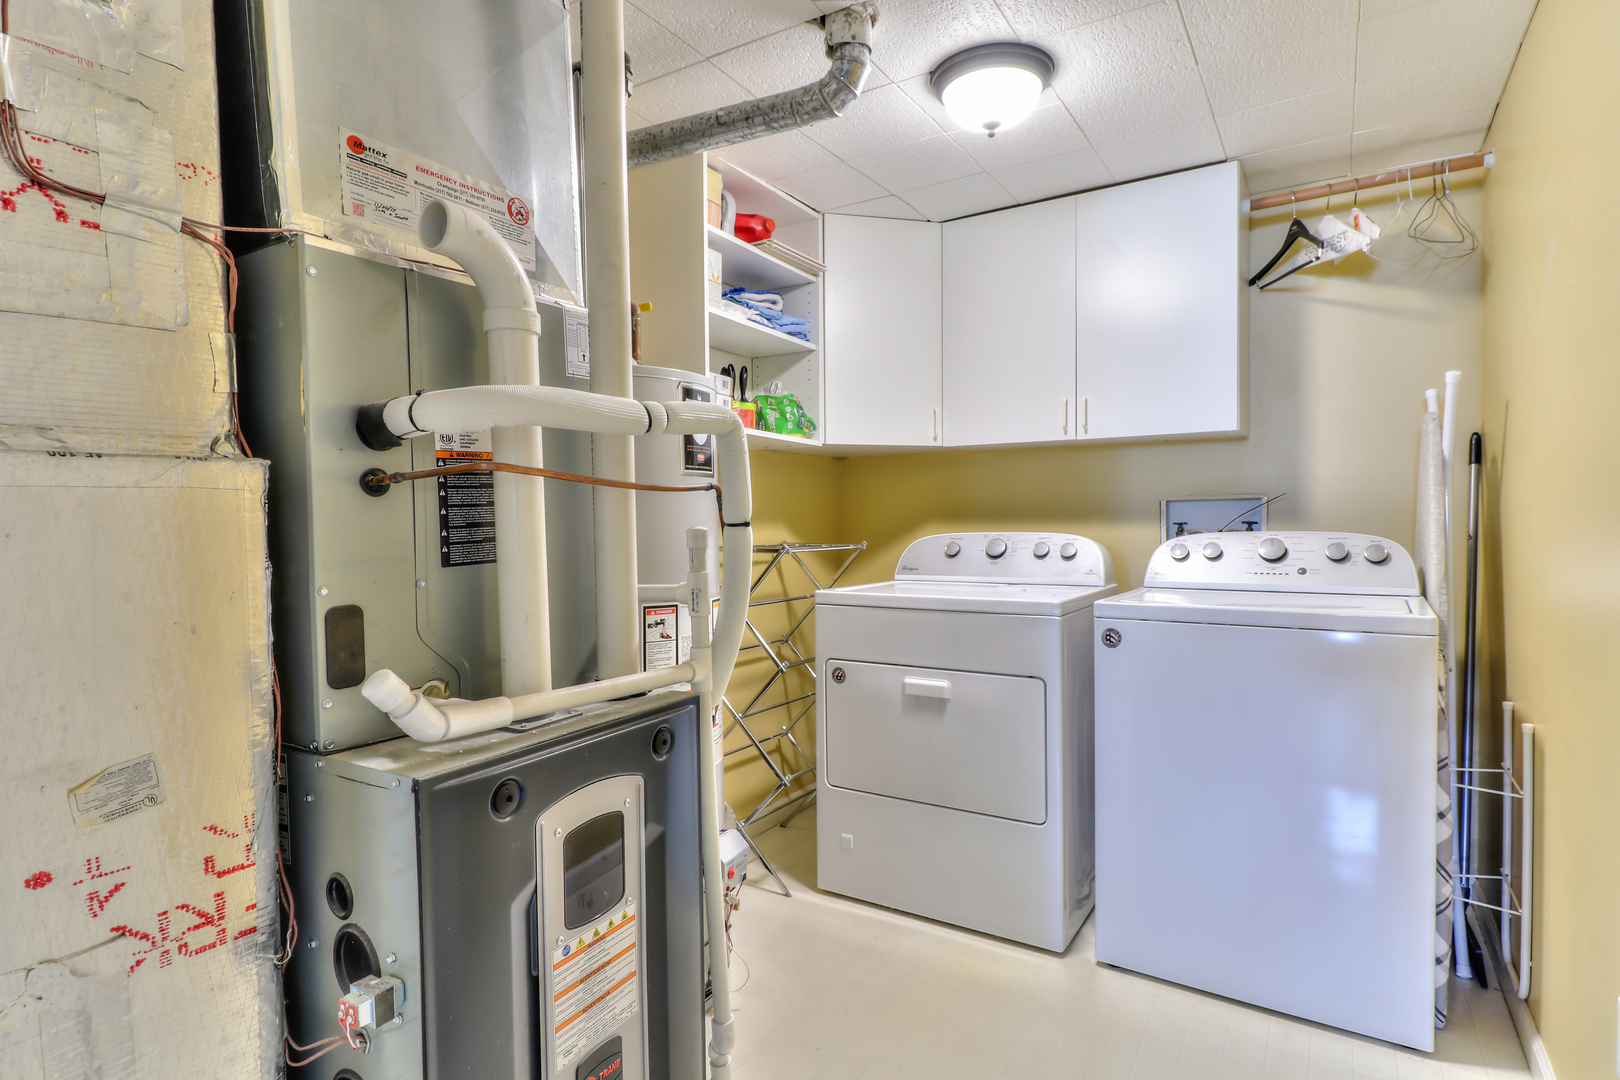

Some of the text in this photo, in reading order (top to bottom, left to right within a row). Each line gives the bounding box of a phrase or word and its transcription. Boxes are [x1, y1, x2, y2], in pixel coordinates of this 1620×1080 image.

[353, 140, 387, 159] Mattex
[413, 179, 435, 192] Monticello
[415, 165, 458, 185] EMERGENCY
[458, 181, 505, 203] INSTRUCTIONS
[598, 1058, 621, 1080] TRANE
